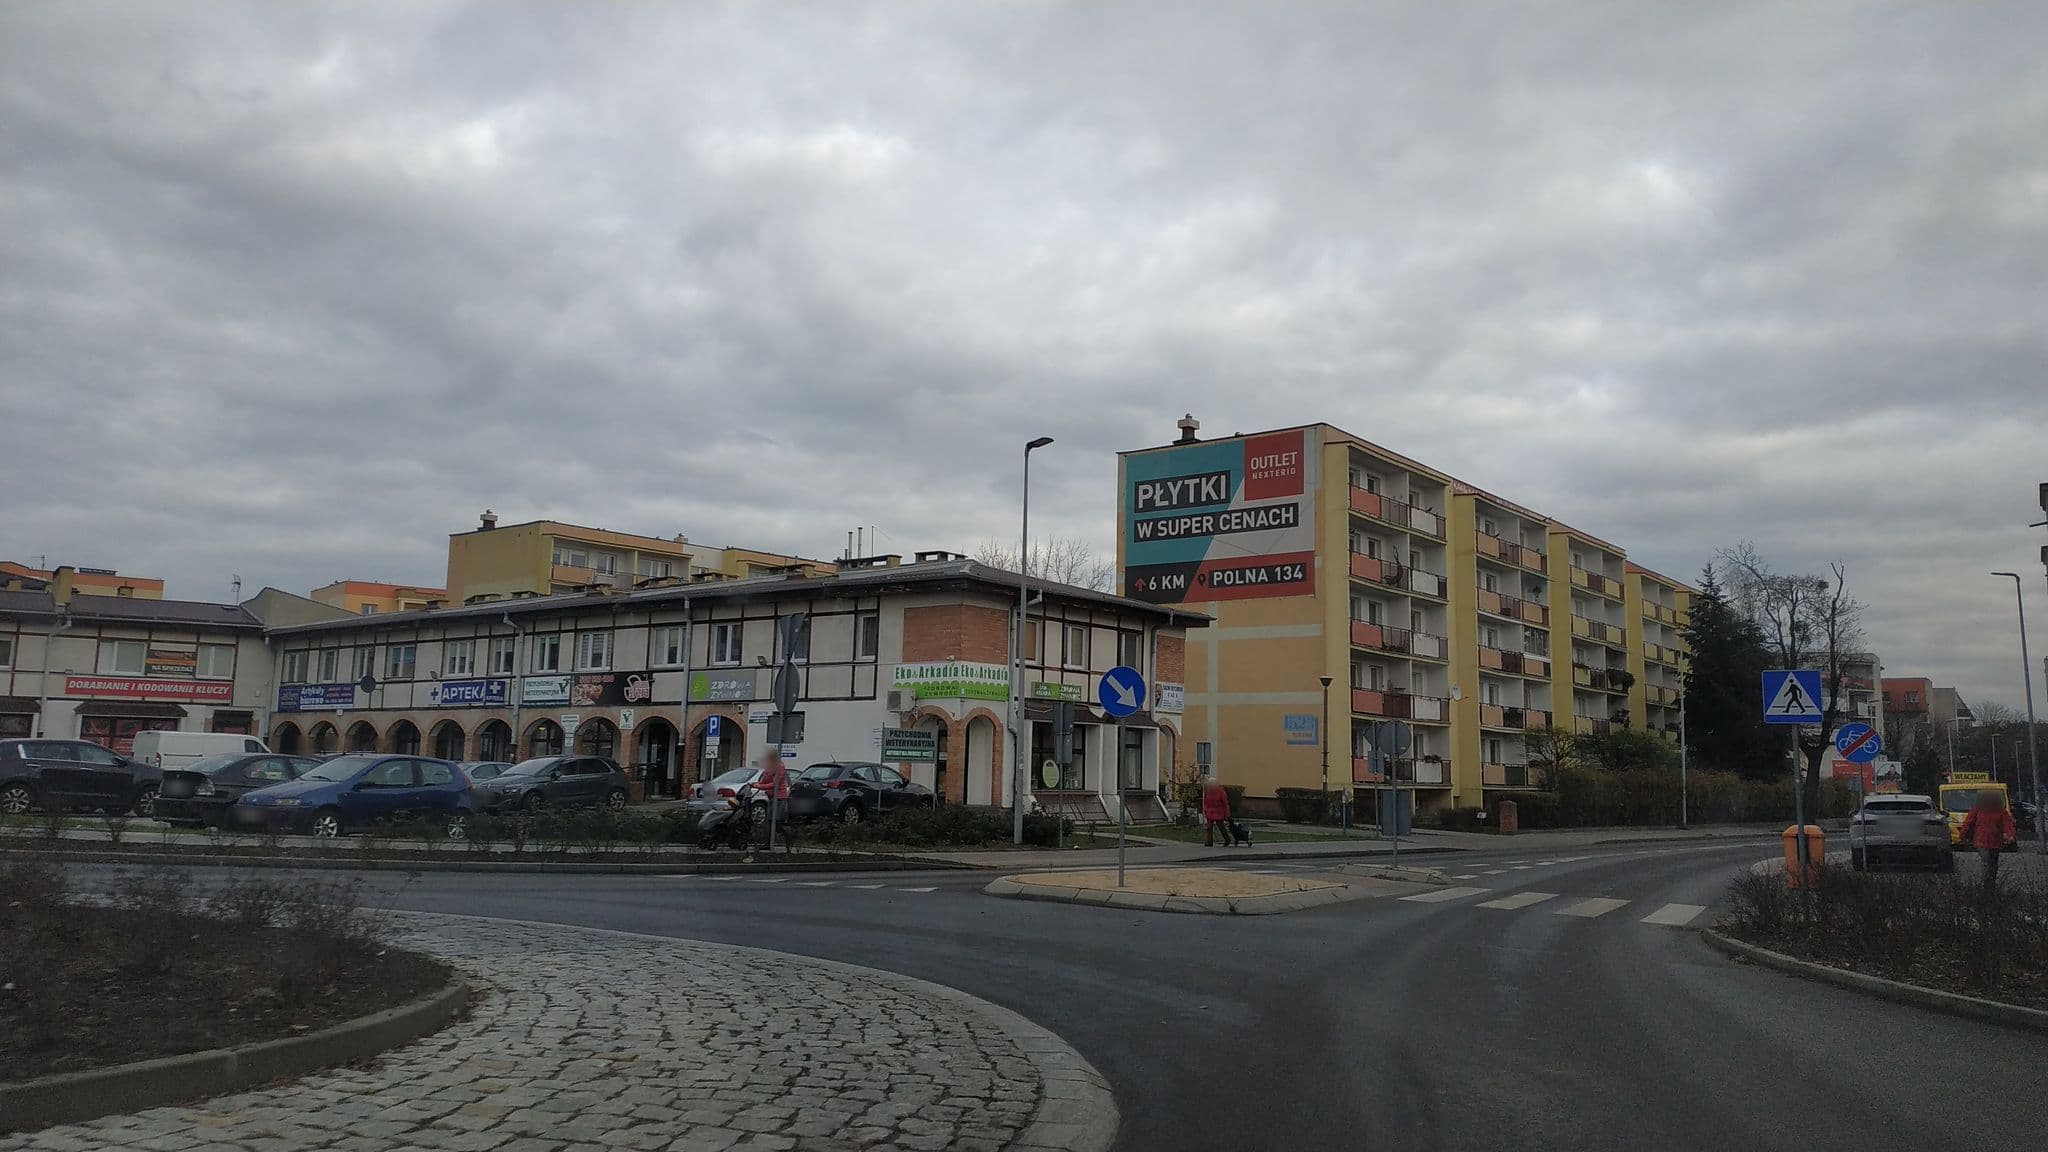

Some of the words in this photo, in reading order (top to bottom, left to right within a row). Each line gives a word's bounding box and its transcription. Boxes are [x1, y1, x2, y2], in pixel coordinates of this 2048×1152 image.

[1250, 451, 1297, 470] OUTLET
[1252, 467, 1297, 480] NEXTERIO
[1137, 475, 1226, 509] PŁYTKI
[1137, 522, 1153, 539] W
[1157, 515, 1214, 536] SUPER
[1219, 506, 1294, 531] CENACH
[1149, 576, 1157, 590] 6
[1161, 574, 1185, 590] KM
[1213, 568, 1268, 586] POLNA
[1274, 565, 1303, 582] 134
[895, 667, 912, 680] Eko
[961, 664, 974, 678] Eko
[69, 680, 129, 690] DORABIANIE
[137, 682, 195, 694] KODOWANIE
[195, 685, 229, 695] KLUCZY
[709, 718, 717, 734] P
[890, 730, 931, 738] PRZYCHODNIA
